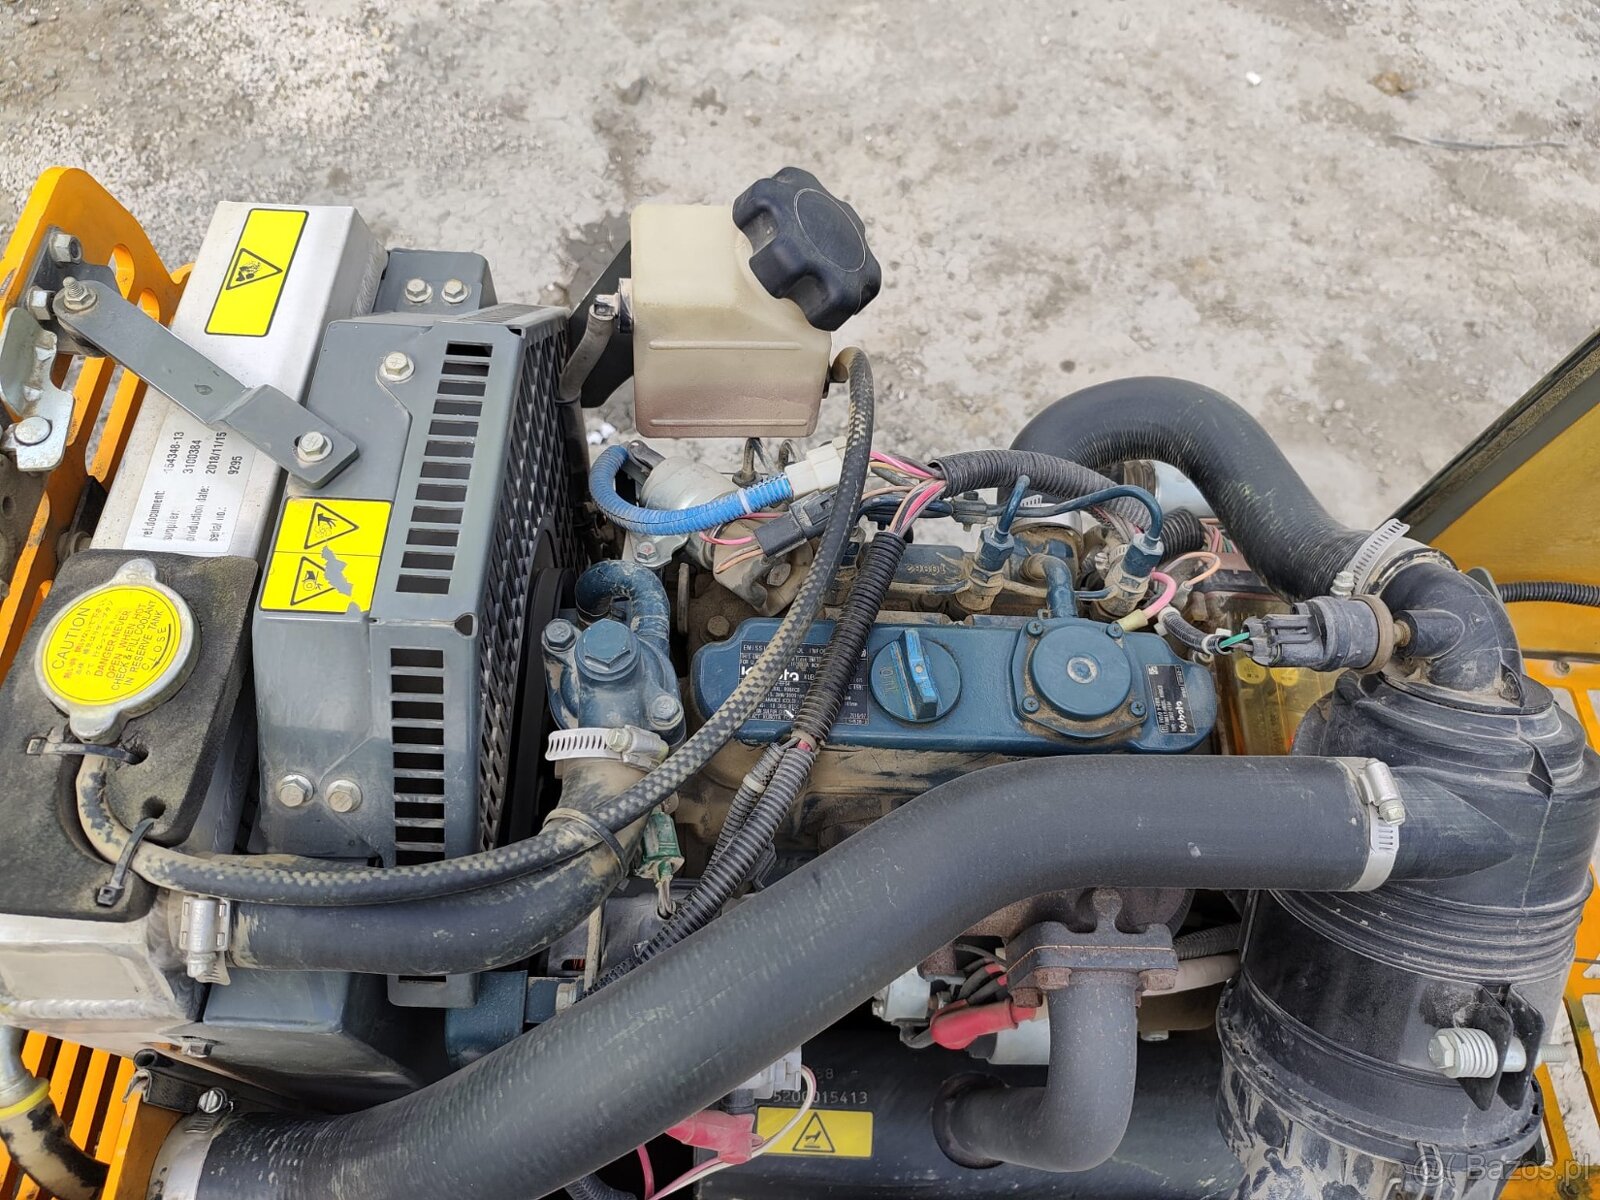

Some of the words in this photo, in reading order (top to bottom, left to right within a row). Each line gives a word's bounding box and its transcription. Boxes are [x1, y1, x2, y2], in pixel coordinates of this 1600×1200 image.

[182, 440, 202, 474] 3100384
[186, 504, 204, 542] production
[195, 485, 210, 502] date:
[205, 431, 227, 474] 2018/11/15
[209, 522, 222, 542] serial
[227, 455, 243, 475] 9295
[51, 607, 91, 670] CAUTION
[94, 640, 117, 677] DANGER
[112, 610, 130, 640] NEVER
[106, 653, 123, 679] OPEN
[118, 623, 136, 649] WHEN
[134, 603, 147, 620] HOT
[111, 661, 129, 691] CHECK
[126, 633, 140, 652] FILL
[135, 600, 157, 635] COOLANT
[124, 677, 135, 686] IN
[130, 634, 153, 673] RESERVE
[147, 610, 163, 630] TANK
[141, 626, 167, 671] CLOSE
[1175, 701, 1188, 732] Kubota
